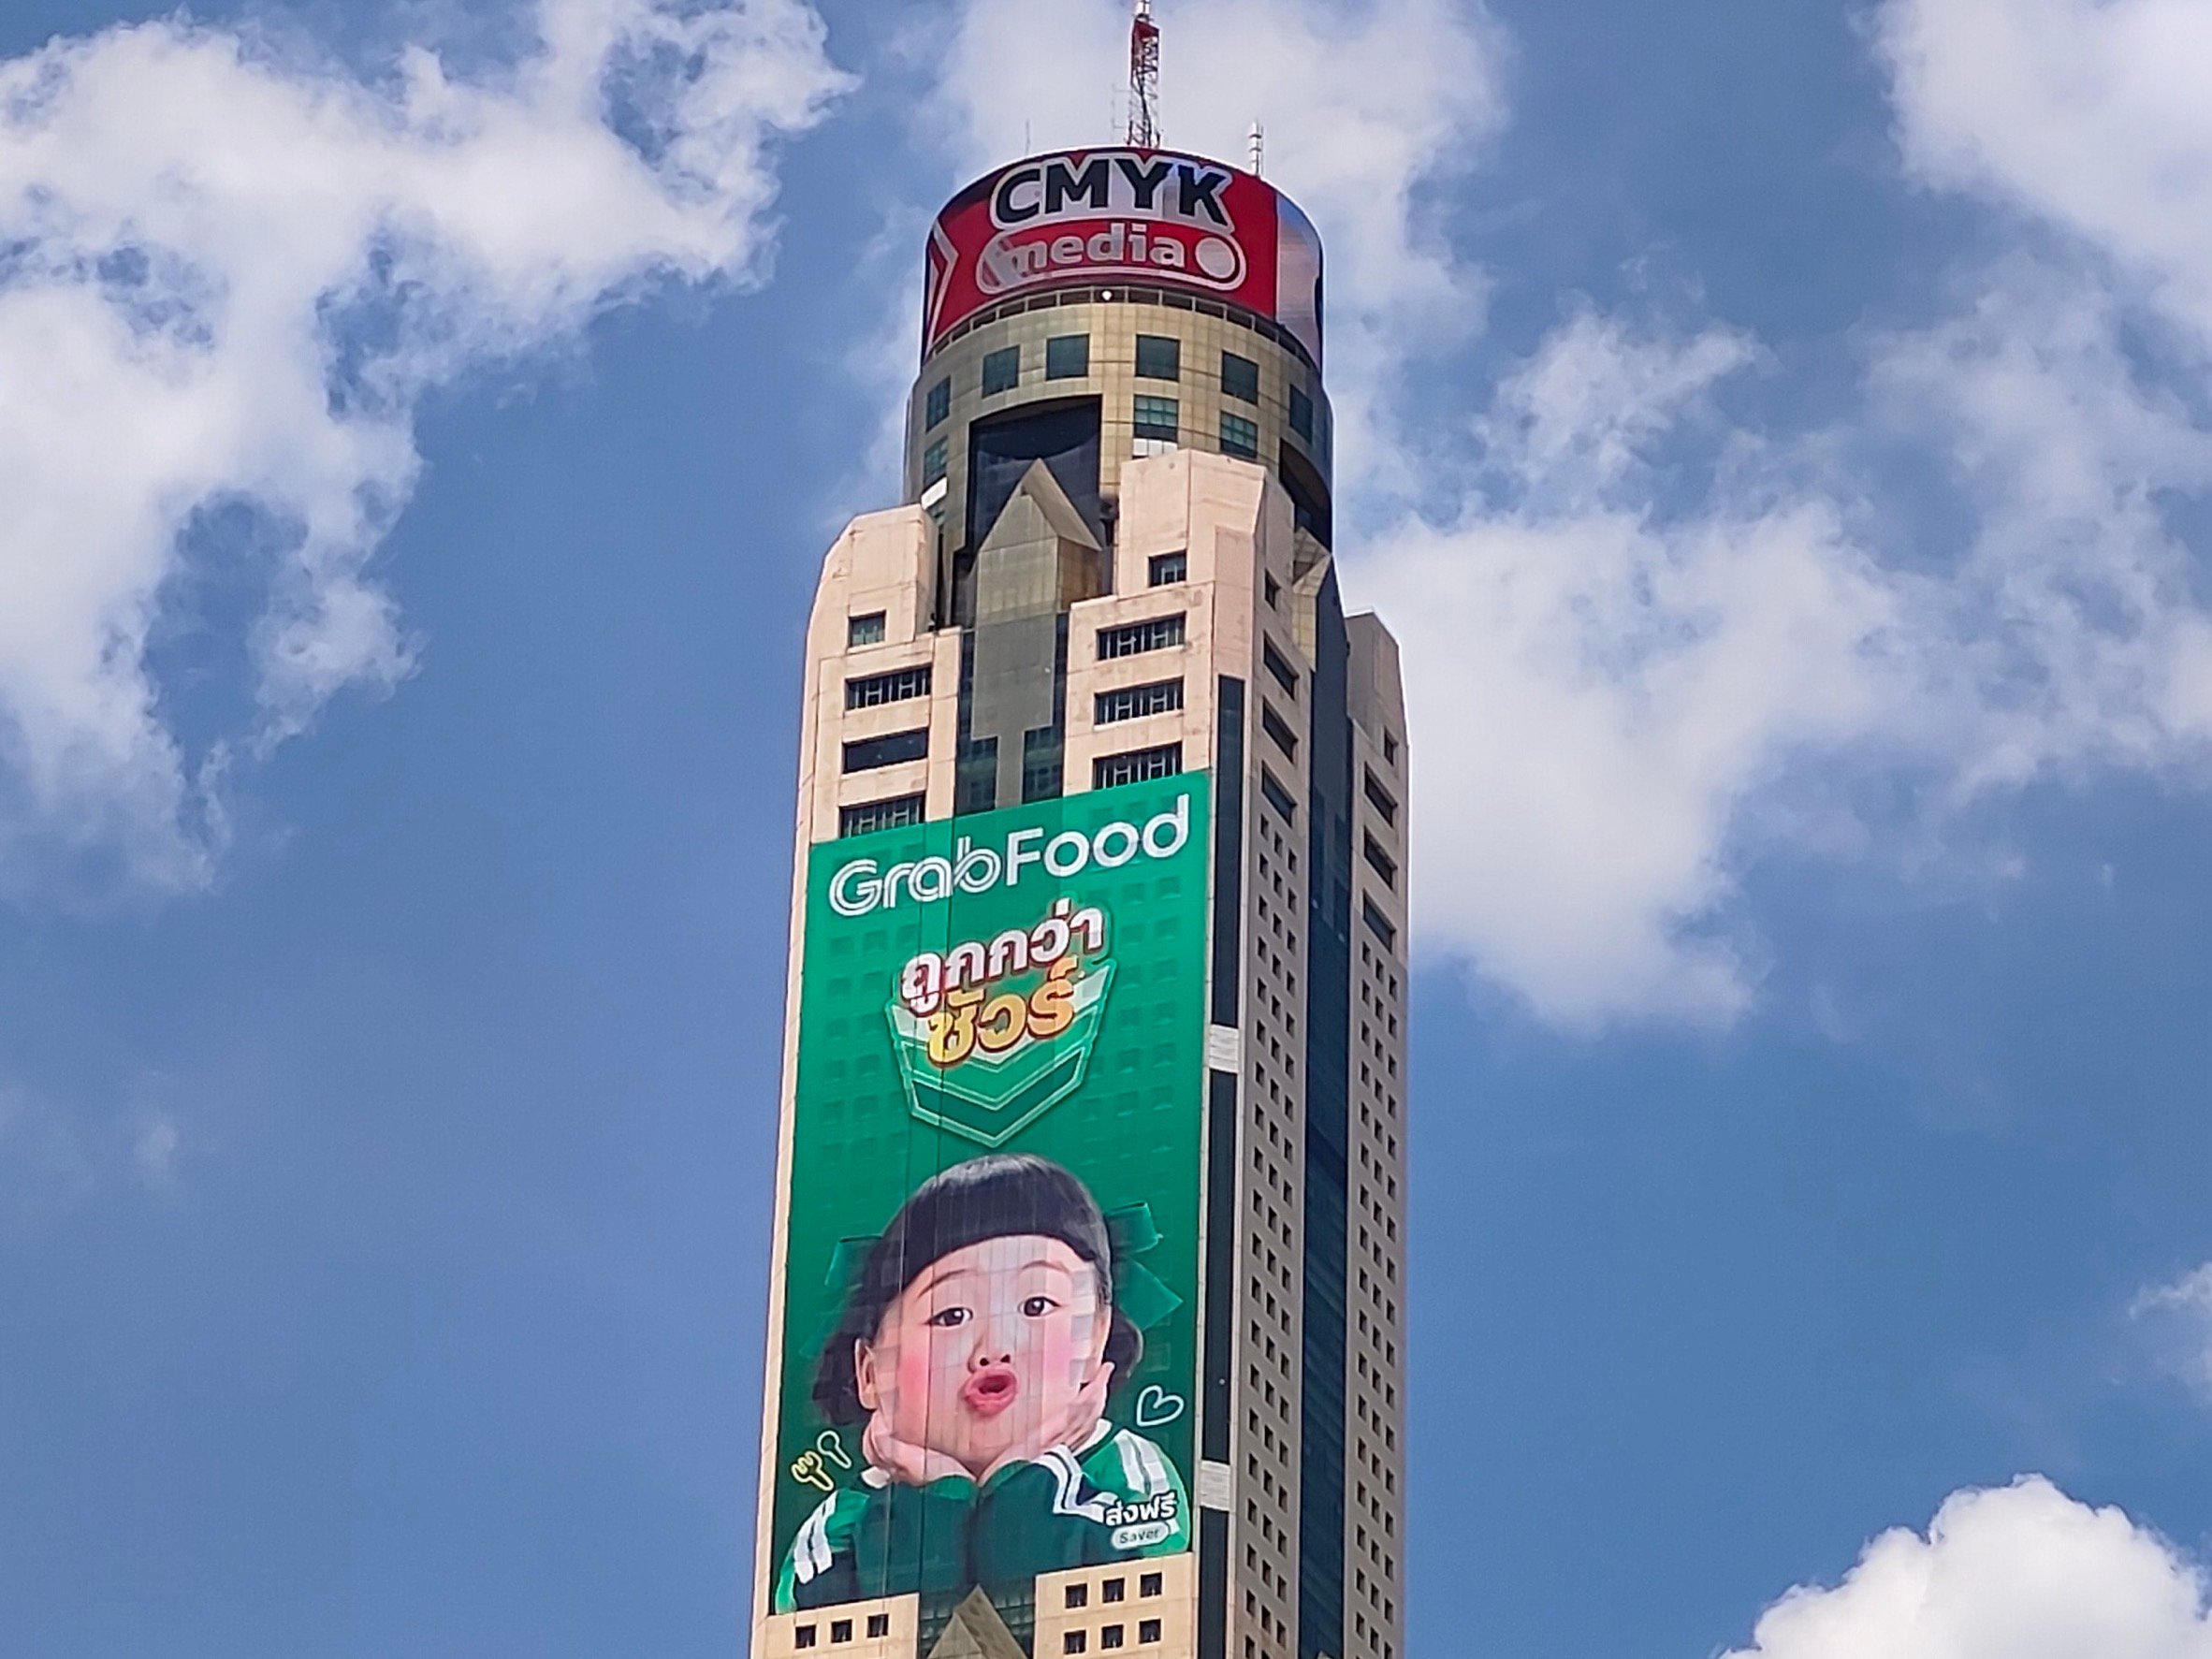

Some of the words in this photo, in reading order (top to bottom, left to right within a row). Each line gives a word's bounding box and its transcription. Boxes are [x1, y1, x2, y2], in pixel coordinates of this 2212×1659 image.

[995, 158, 1227, 226] CMYK
[1011, 222, 1186, 269] media
[829, 793, 1189, 916] GrabFood
[901, 897, 1104, 1016] ถูกกว่า
[927, 954, 1077, 1065] ชัวร์
[1105, 1492, 1177, 1526] ส่งฟรี
[1119, 1528, 1160, 1544] Saver
